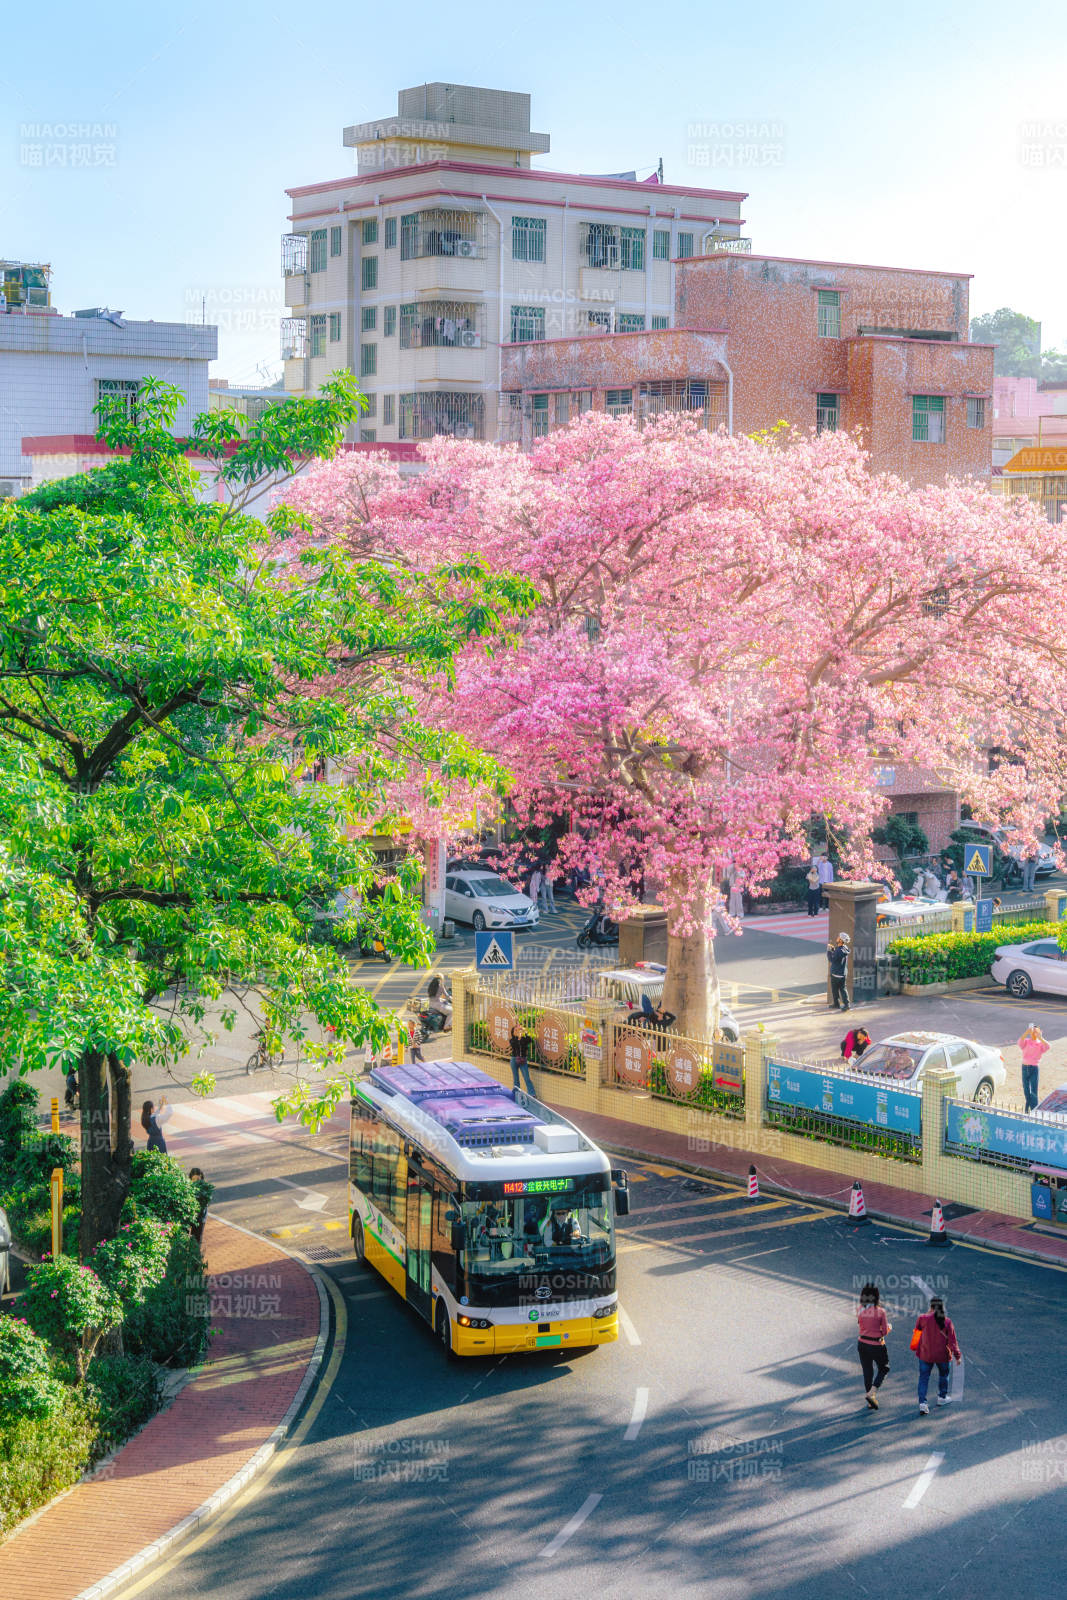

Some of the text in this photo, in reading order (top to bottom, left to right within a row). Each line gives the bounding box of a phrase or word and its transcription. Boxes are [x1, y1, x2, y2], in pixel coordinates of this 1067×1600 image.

[544, 1027, 558, 1040] 公正
[544, 1039, 558, 1052] 法治
[625, 1046, 641, 1059] 爱国
[625, 1058, 641, 1072] 敬业
[675, 1057, 692, 1072] 诚信
[675, 1071, 692, 1085] 友善
